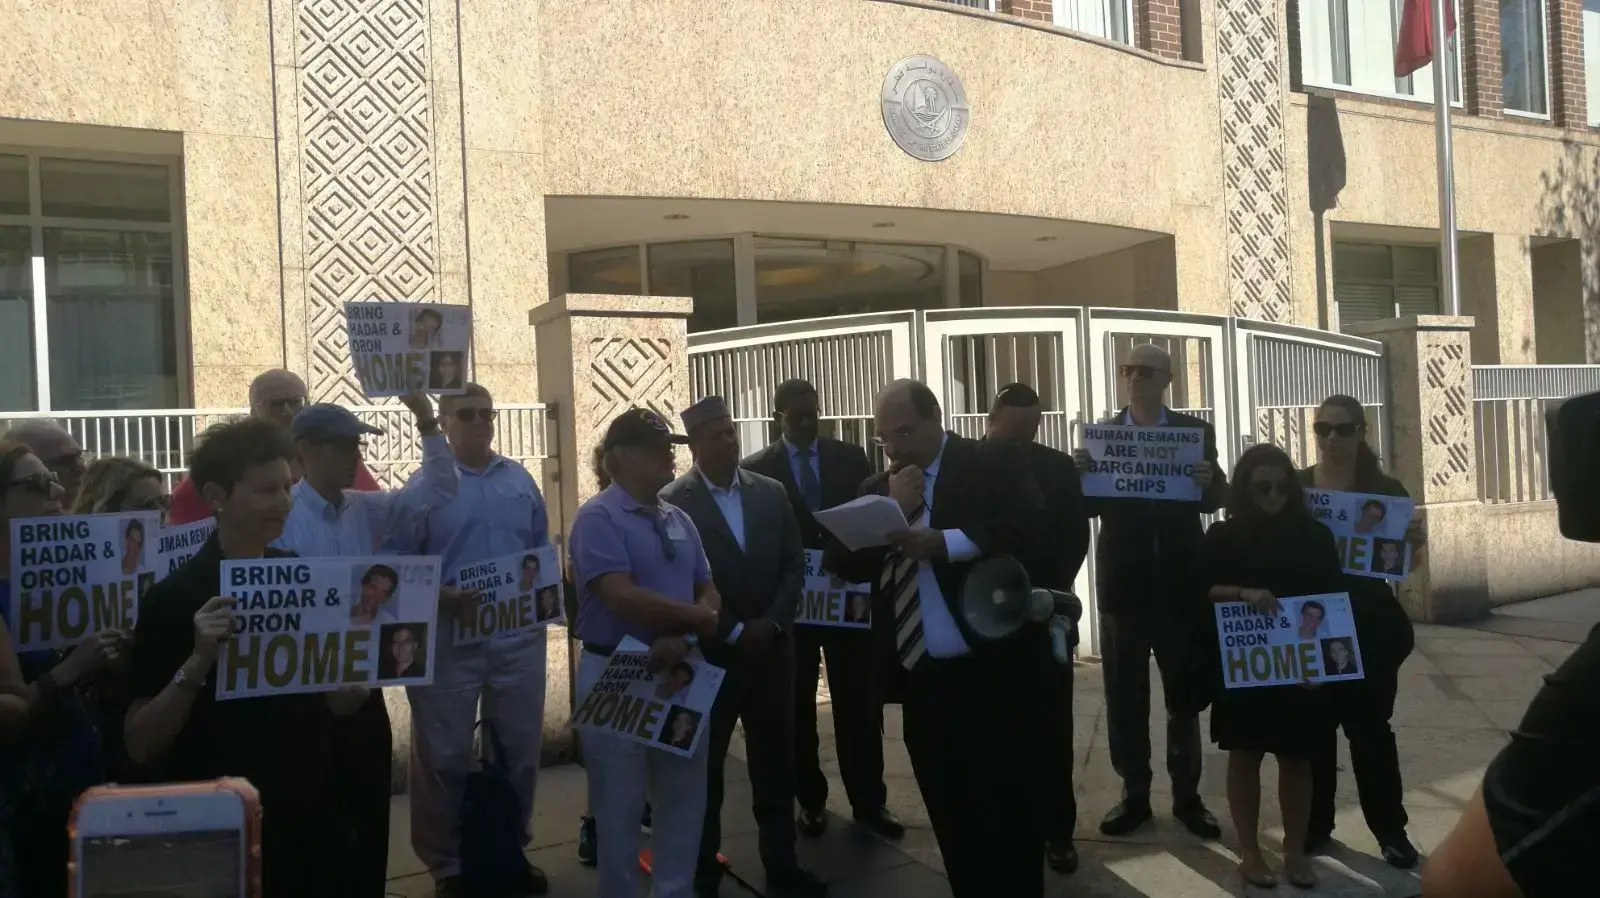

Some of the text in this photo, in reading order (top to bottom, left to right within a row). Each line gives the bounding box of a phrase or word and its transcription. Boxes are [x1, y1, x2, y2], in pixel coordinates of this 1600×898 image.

[347, 306, 384, 320] BRING
[350, 322, 402, 336] HADAR &
[352, 339, 382, 353] ORON
[1085, 428, 1200, 444] HUMAN REMAINS
[1103, 444, 1179, 459] ARE NOT
[1115, 478, 1166, 493] CHIPS
[20, 521, 90, 544] BRING
[21, 540, 116, 567] HADAR &
[21, 565, 87, 590] ORON
[231, 564, 311, 587] BRING
[460, 562, 497, 581] BRING
[506, 572, 514, 584] &
[231, 587, 341, 611] HADAR &
[19, 579, 135, 645] HOME
[1221, 603, 1267, 618] BRIN
[231, 612, 301, 634] ORON
[1223, 616, 1291, 633] HADAR &
[1225, 633, 1268, 648] ORON
[225, 630, 371, 692] HOME
[1226, 642, 1320, 683] HOME
[592, 682, 630, 693] ORON
[572, 693, 664, 739] HOME
